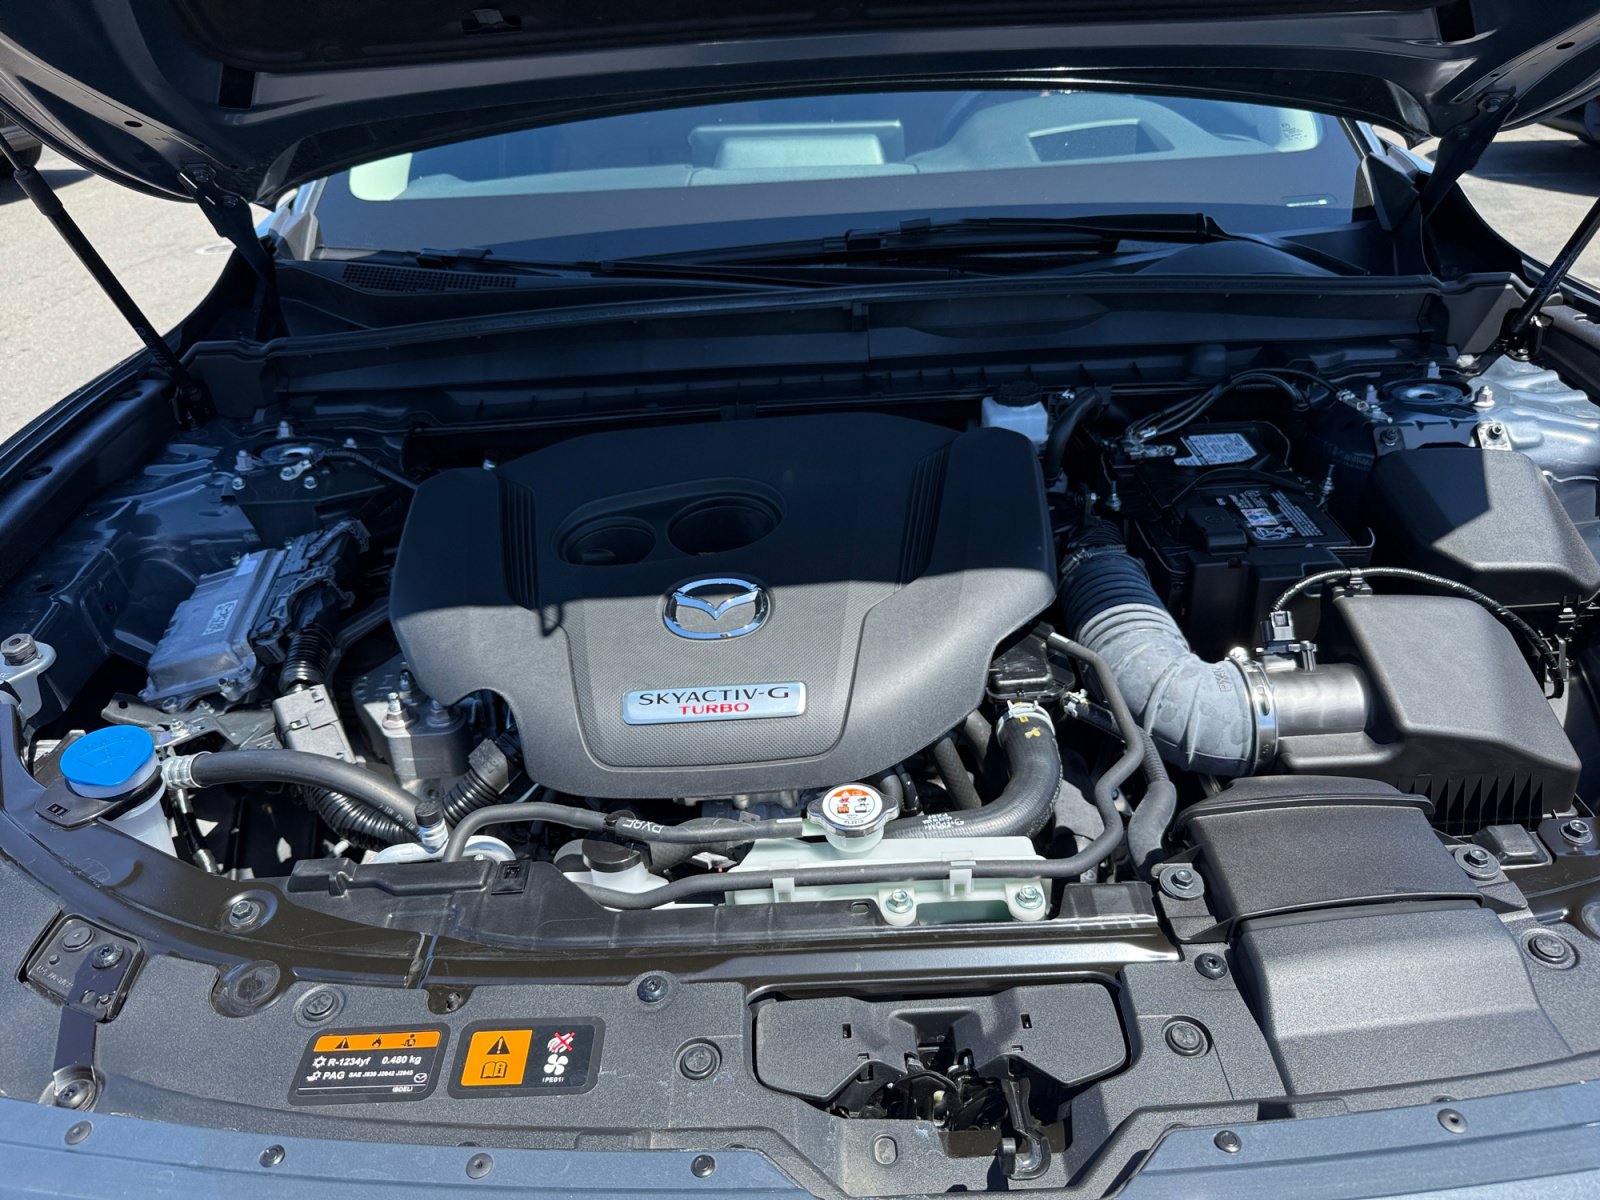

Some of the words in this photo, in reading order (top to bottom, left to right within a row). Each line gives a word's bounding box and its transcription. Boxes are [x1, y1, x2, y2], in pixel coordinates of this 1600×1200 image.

[638, 686, 789, 706] SKYACTIV-G
[678, 702, 750, 715] TURBO
[327, 1056, 371, 1067] R-1234yf
[381, 1055, 408, 1065] 0.480
[408, 1054, 422, 1065] kg
[322, 1071, 345, 1081] PAG
